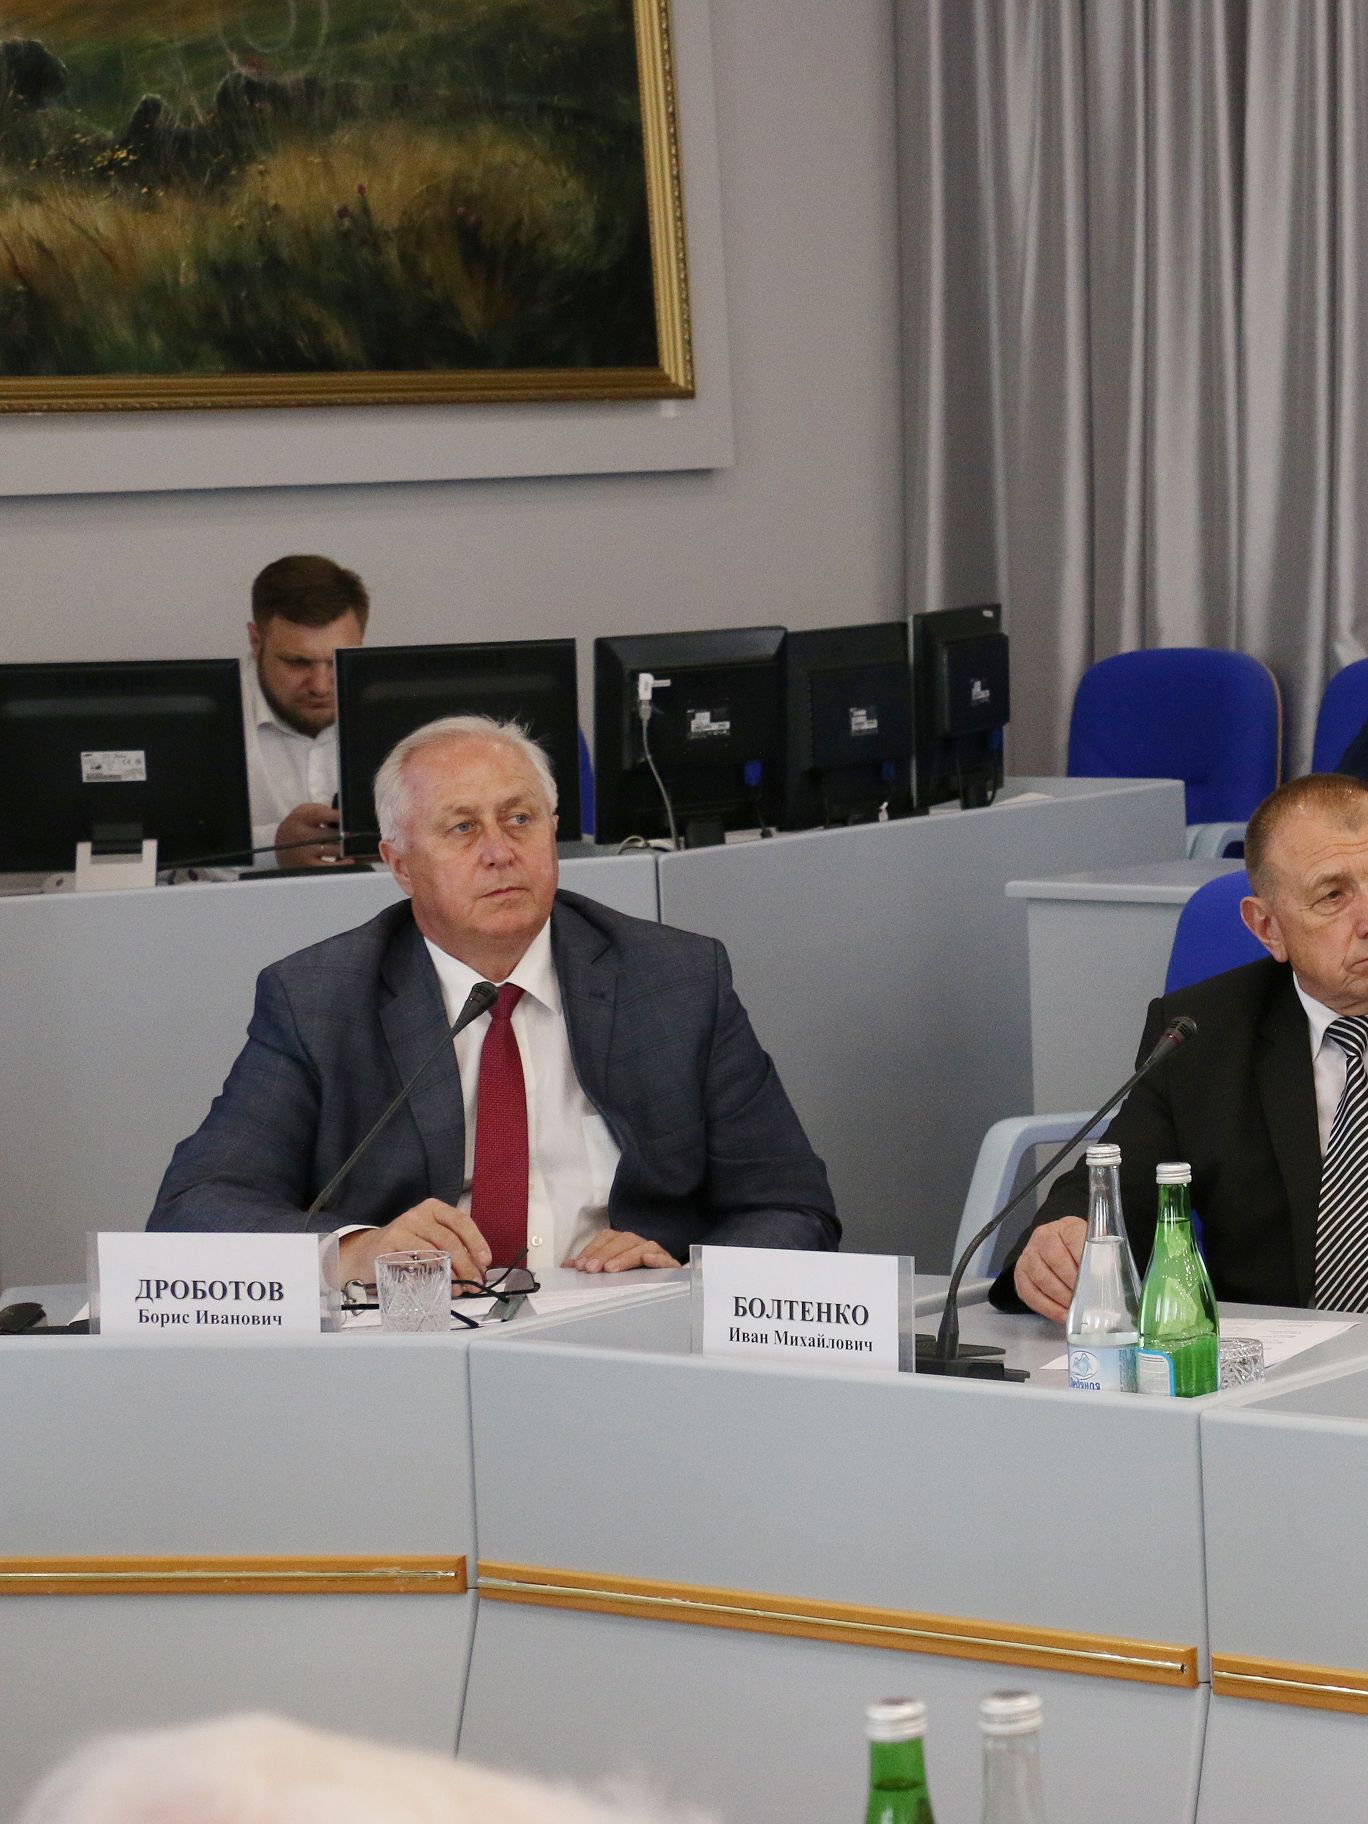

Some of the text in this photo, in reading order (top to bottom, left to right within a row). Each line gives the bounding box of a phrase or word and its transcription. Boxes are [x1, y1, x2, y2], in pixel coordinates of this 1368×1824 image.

[135, 1279, 285, 1303] ДРОБОТОВ
[138, 1309, 282, 1327] Борис Иванович
[733, 1296, 870, 1326] БОЛТЕНКО
[728, 1326, 873, 1352] Иван Михайлович
